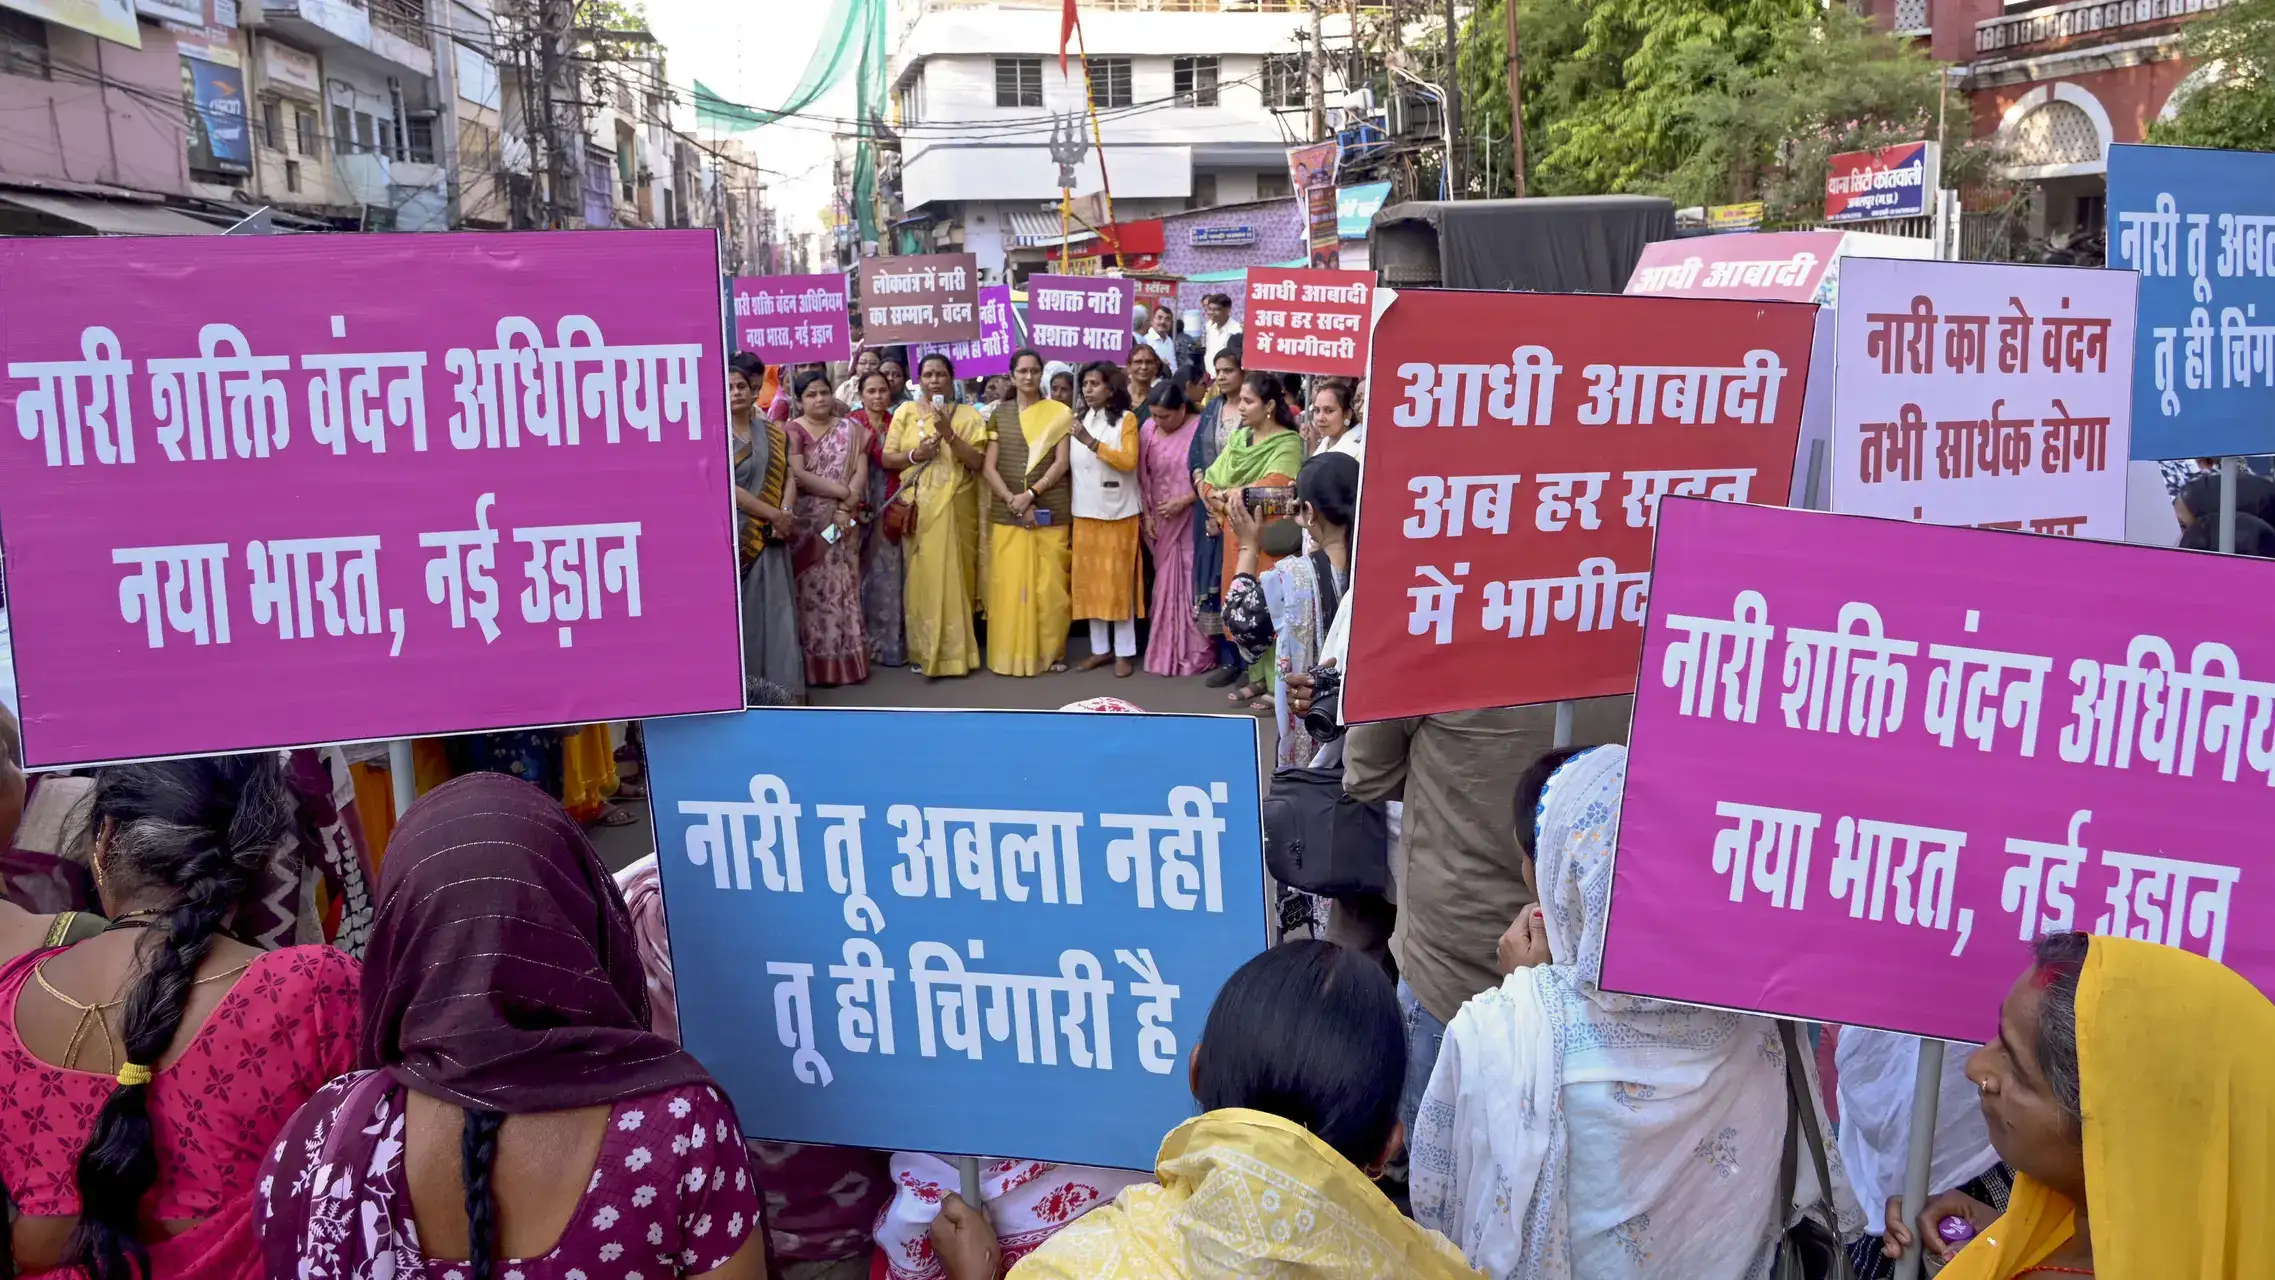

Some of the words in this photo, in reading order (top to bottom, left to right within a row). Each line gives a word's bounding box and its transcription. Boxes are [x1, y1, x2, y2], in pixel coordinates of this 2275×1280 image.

[1828, 176, 1850, 194] थाना
[1851, 167, 1872, 192] सिटी
[1874, 159, 1922, 189] कोतवाली
[872, 268, 920, 294] लोकतंत्र
[920, 266, 935, 292] में
[938, 266, 966, 291] नारी
[1633, 256, 1703, 292] आधी
[1702, 252, 1818, 288] आबादी
[2119, 192, 2180, 277] नारी
[2187, 214, 2212, 304] तू
[752, 291, 774, 316] शक्ति
[776, 289, 796, 314] वंदन
[799, 288, 843, 313] अधिनियम
[868, 306, 887, 327] का
[942, 297, 972, 323] वंदन
[1037, 289, 1085, 312] सशक्त
[1087, 286, 1122, 315] नारी
[1251, 280, 1297, 301] आधी
[1302, 283, 1368, 304] आबादी
[1255, 310, 1287, 327] अब
[1291, 312, 1313, 329] हर
[1316, 313, 1362, 332] सदन
[746, 329, 764, 347] नया
[767, 328, 793, 349] भारत,
[795, 320, 809, 347] नई
[810, 325, 833, 348] उड़ान
[952, 342, 969, 360] नाम
[981, 331, 999, 357] नारी
[998, 330, 1009, 354] है
[1033, 324, 1080, 348] सशक्त
[1082, 327, 1124, 351] भारत
[1257, 332, 1274, 353] में
[1277, 335, 1355, 359] भागीदारी
[1867, 295, 1938, 374] नारी
[1944, 315, 1990, 374] का
[1998, 297, 2033, 374] हो
[2042, 297, 2111, 374] वंदन
[2154, 328, 2180, 417] तू
[2183, 307, 2214, 389] ही
[2221, 304, 2275, 389] चिंग
[8, 326, 136, 466] नारी
[147, 323, 290, 462] शक्ति
[301, 315, 428, 455] वंदन
[445, 315, 702, 450] अधिनियम
[1393, 345, 1562, 428] आधी
[1577, 349, 1787, 425] आबादी
[1860, 403, 1927, 484] तभी
[1936, 399, 2034, 480] सार्थक
[2041, 399, 2110, 474] होगा
[1403, 474, 1521, 539] अब
[1535, 472, 1610, 532] हर
[112, 543, 231, 648] नया
[246, 535, 404, 657] भारत,
[419, 492, 501, 644] नई
[513, 522, 641, 647] उड़ान
[1406, 562, 1470, 645] में
[1482, 557, 1651, 638] भागीद
[1662, 590, 1774, 723] नारी
[1780, 601, 1918, 738] शक्ति
[1924, 609, 2053, 757] वंदन
[2058, 634, 2275, 787] अधिनिय
[678, 774, 803, 893] नारी
[816, 804, 885, 934] तू
[887, 804, 1083, 904] अबला
[1100, 782, 1228, 913] नहीं
[1712, 801, 1821, 910] नया
[1829, 815, 1974, 957] भारत,
[2001, 809, 2092, 941] नई
[766, 961, 833, 1087] तू
[829, 938, 895, 1055] ही
[909, 939, 1114, 1070] चिंगारी
[1114, 948, 1180, 1075] है
